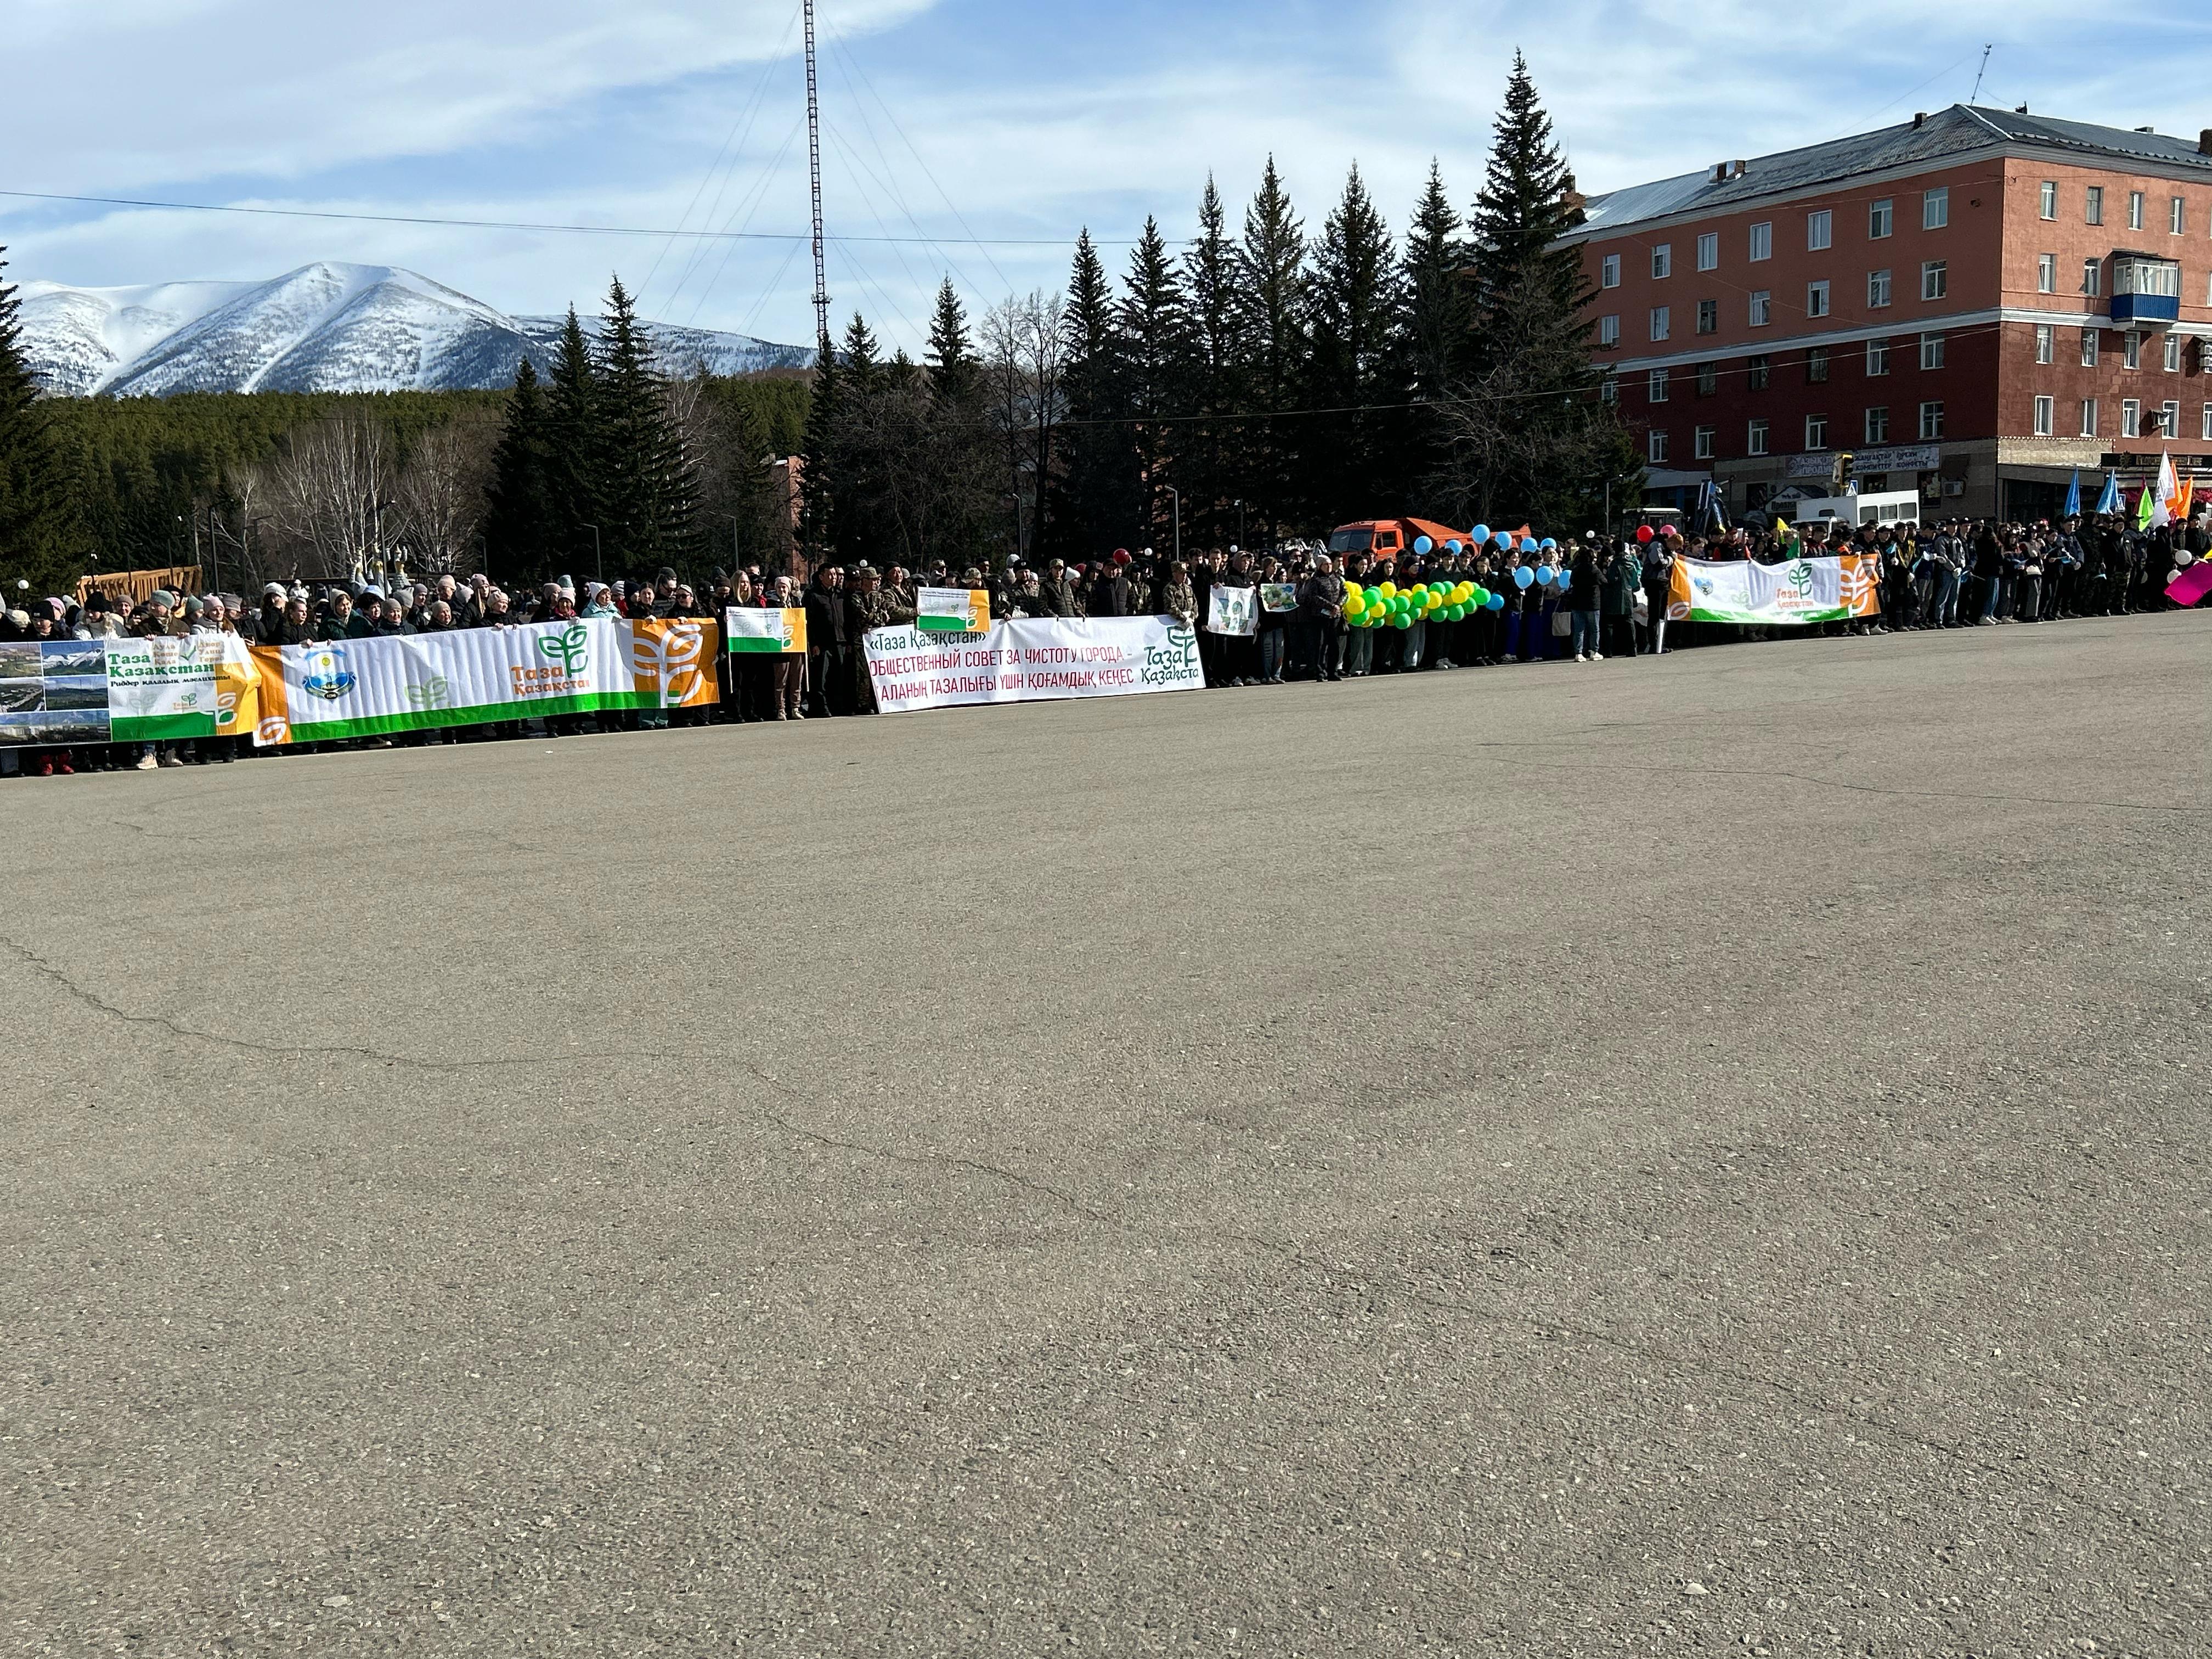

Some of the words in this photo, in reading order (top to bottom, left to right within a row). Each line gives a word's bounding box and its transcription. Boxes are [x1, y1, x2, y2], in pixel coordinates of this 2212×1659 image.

[1802, 465, 1833, 475] ПРОДУК
[870, 633, 906, 651] «Таза
[910, 631, 986, 650] Қазақстан»
[108, 653, 150, 664] Таза
[869, 649, 961, 677] ОБЩЕСТВЕННЫЙ
[965, 650, 1003, 667] СОВЕТ
[1006, 649, 1020, 665] ЗА
[1025, 648, 1077, 664] ЧИСТОТУ
[1080, 646, 1124, 663] ГОРОДА
[1144, 646, 1182, 670] Таза
[109, 663, 215, 678] Қазақстан
[511, 666, 564, 681] Таза
[1141, 665, 1199, 685] Қазақста
[877, 680, 928, 702] АЛАНЫҢ
[930, 675, 996, 696] ТАЗАЛЫҒЫ
[1000, 673, 1024, 690] ҮШІН
[1028, 670, 1097, 691] ҚОҒАМДЫҚ
[1099, 668, 1134, 687] КЕҢЕС
